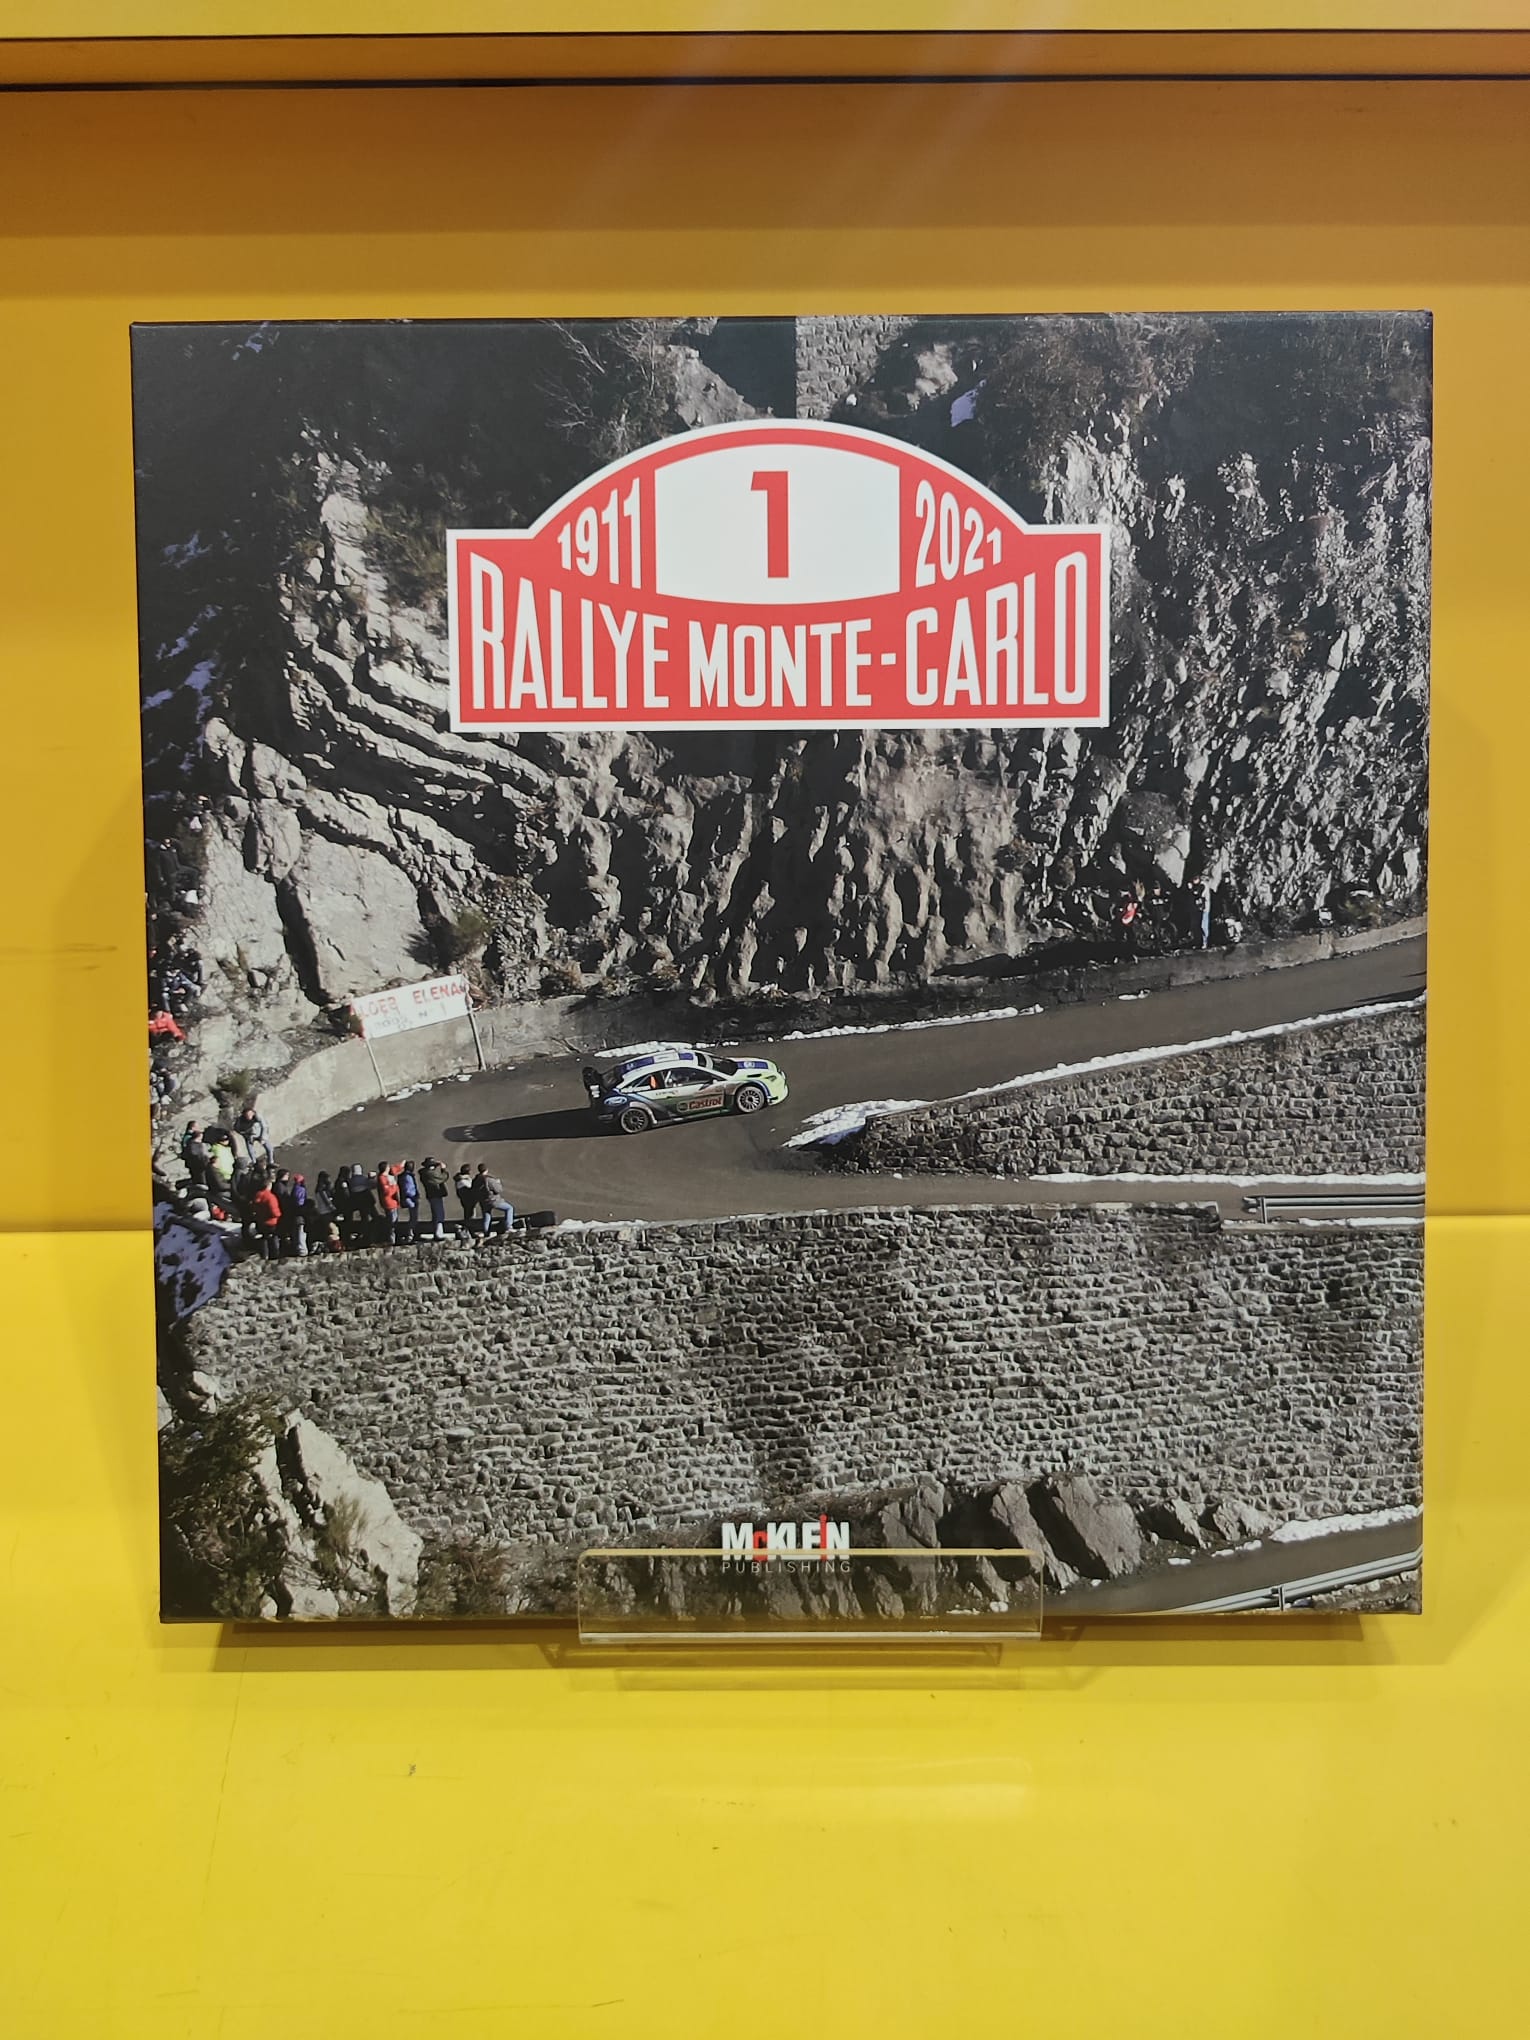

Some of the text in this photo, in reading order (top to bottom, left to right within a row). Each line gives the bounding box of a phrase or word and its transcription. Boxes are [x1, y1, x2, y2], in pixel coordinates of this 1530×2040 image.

[558, 478, 642, 590] 1911
[751, 470, 790, 579] 1
[915, 479, 1002, 588] 2021
[470, 551, 1088, 710] RALLYE MONTE-CARLO
[721, 1560, 851, 1574] PUBLISHING
